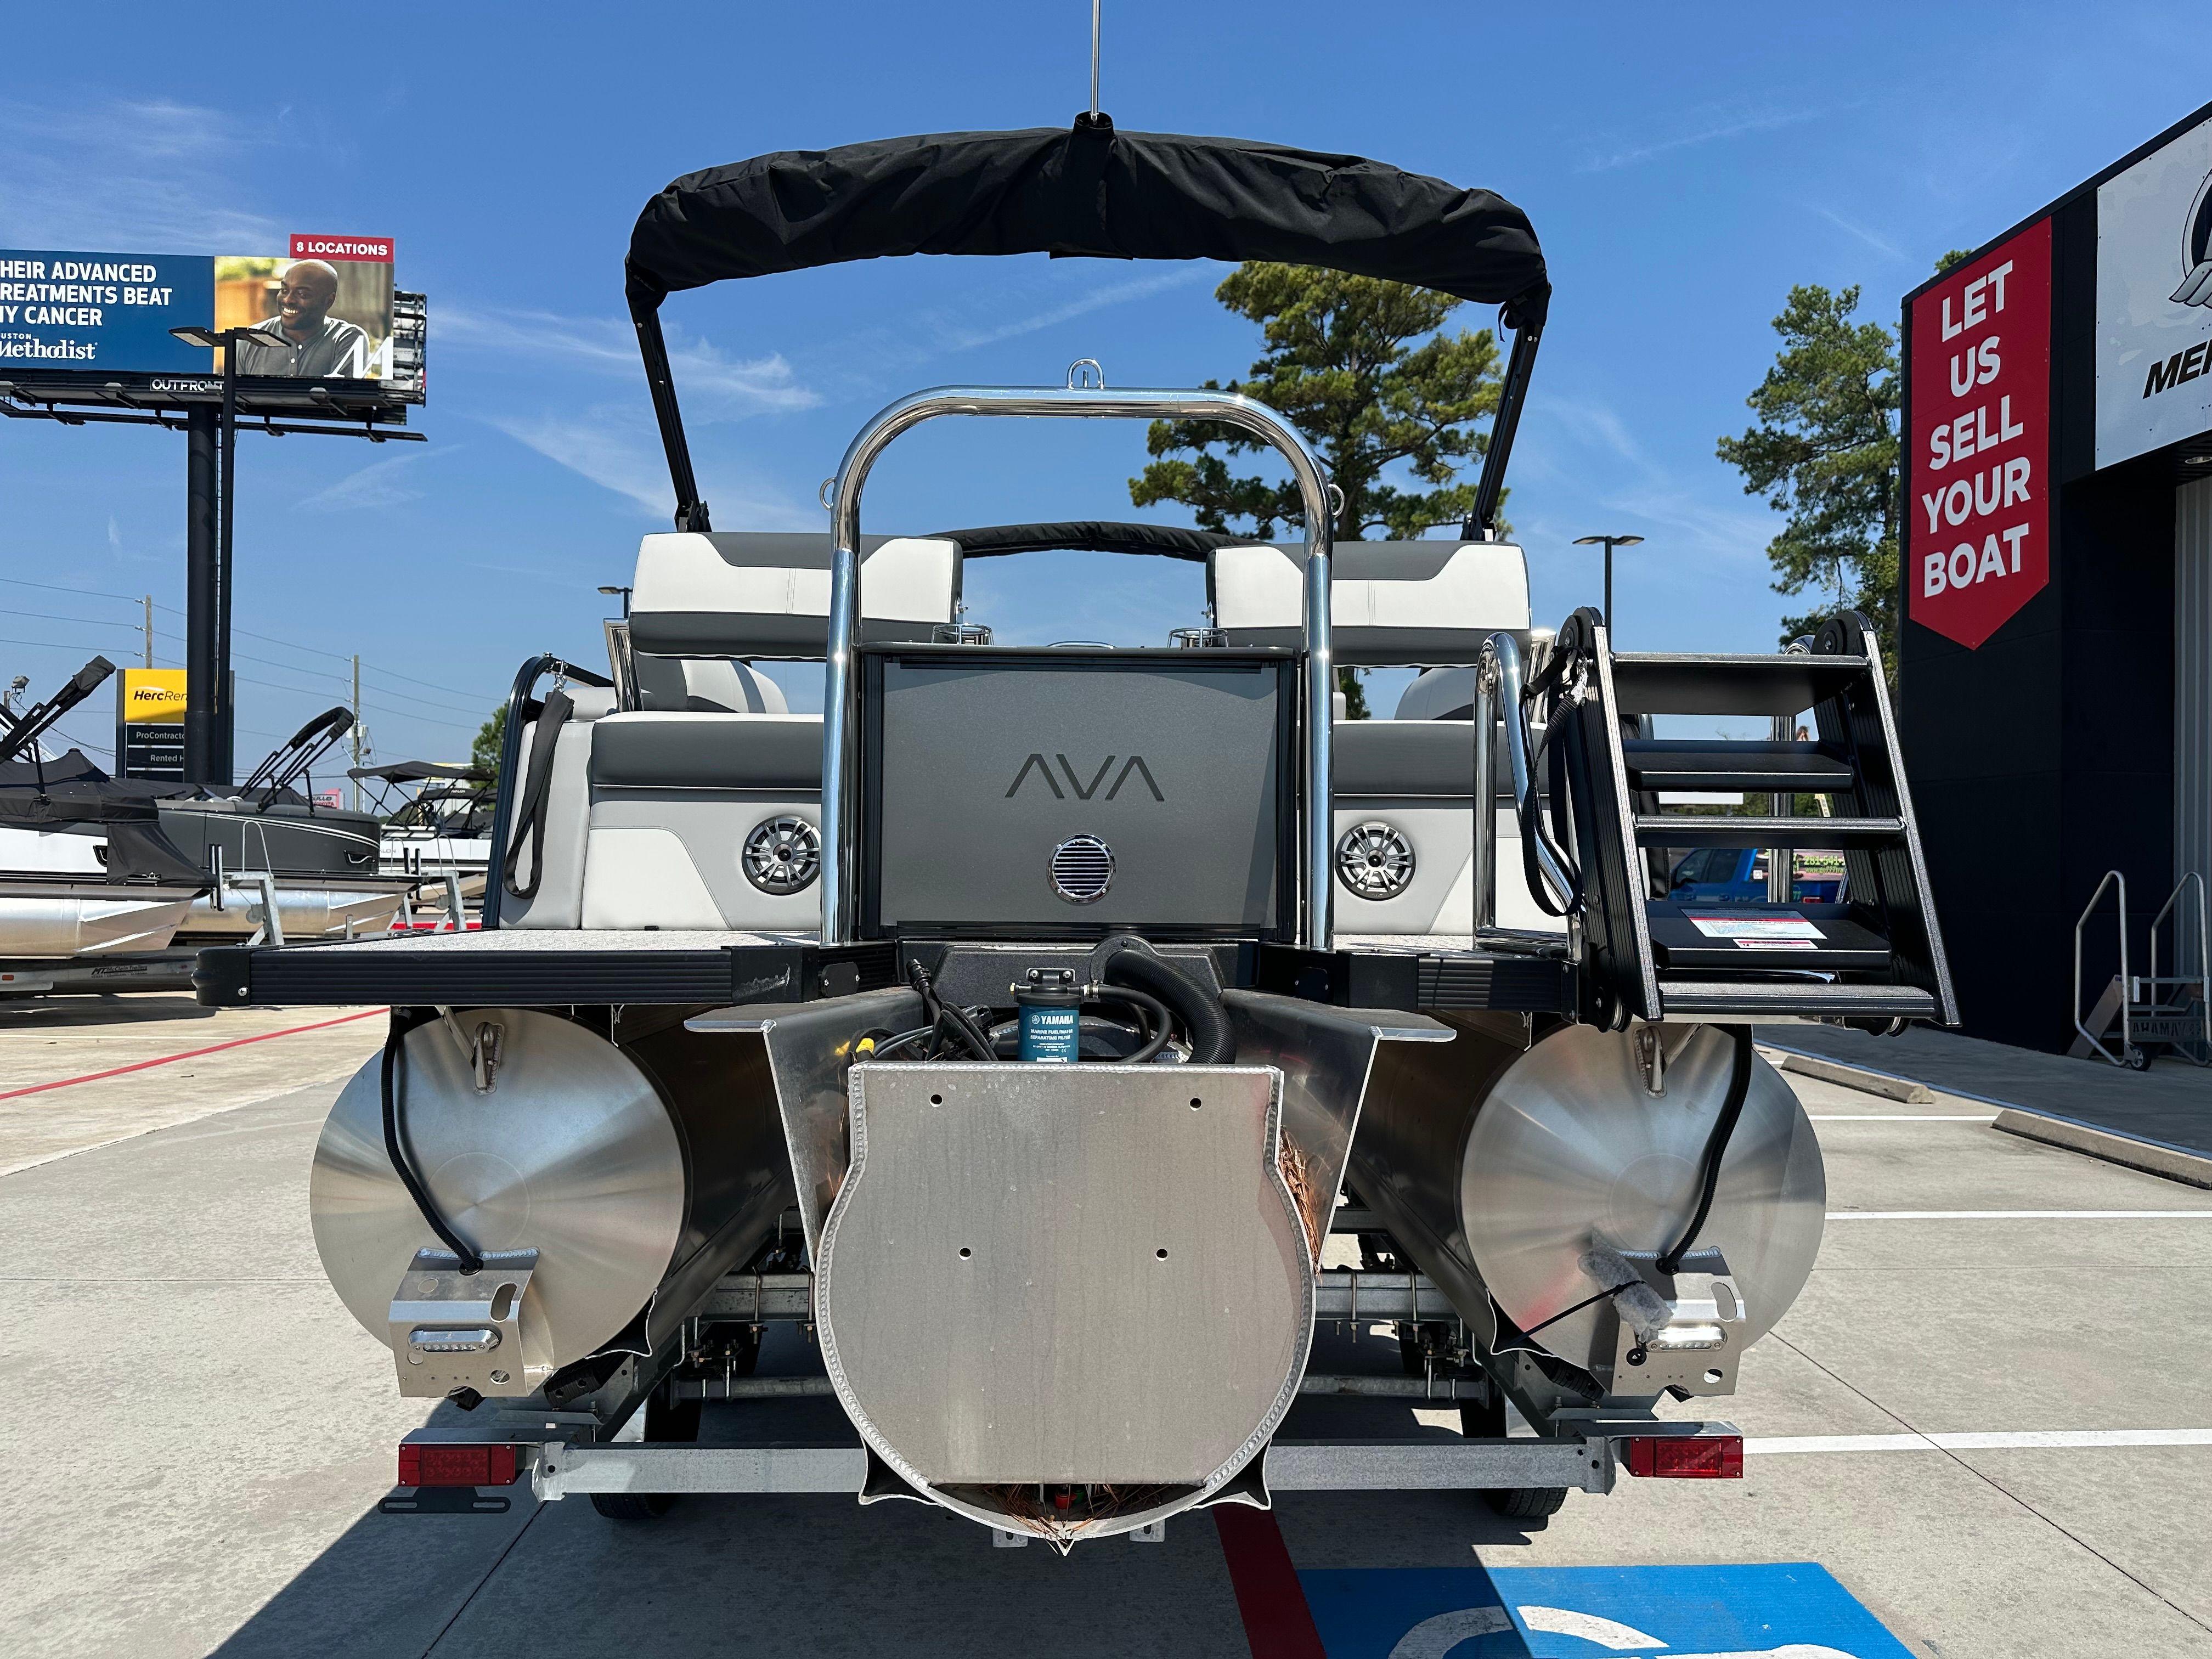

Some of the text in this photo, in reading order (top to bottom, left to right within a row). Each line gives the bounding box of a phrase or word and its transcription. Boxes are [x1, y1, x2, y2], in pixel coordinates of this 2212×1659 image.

[296, 241, 388, 256] 8 LOCATIONS
[0, 260, 156, 283] HEIR ADVANCED
[0, 283, 172, 306] REATMENTS BEAT
[1942, 259, 2013, 342] LET
[25, 306, 103, 326] CANCER
[1950, 336, 2001, 398] US
[1928, 394, 2024, 471] SELL
[1922, 456, 2031, 534] YOUR
[1924, 523, 2029, 599] BOAT
[1041, 1015, 1074, 1024] YAMAHA
